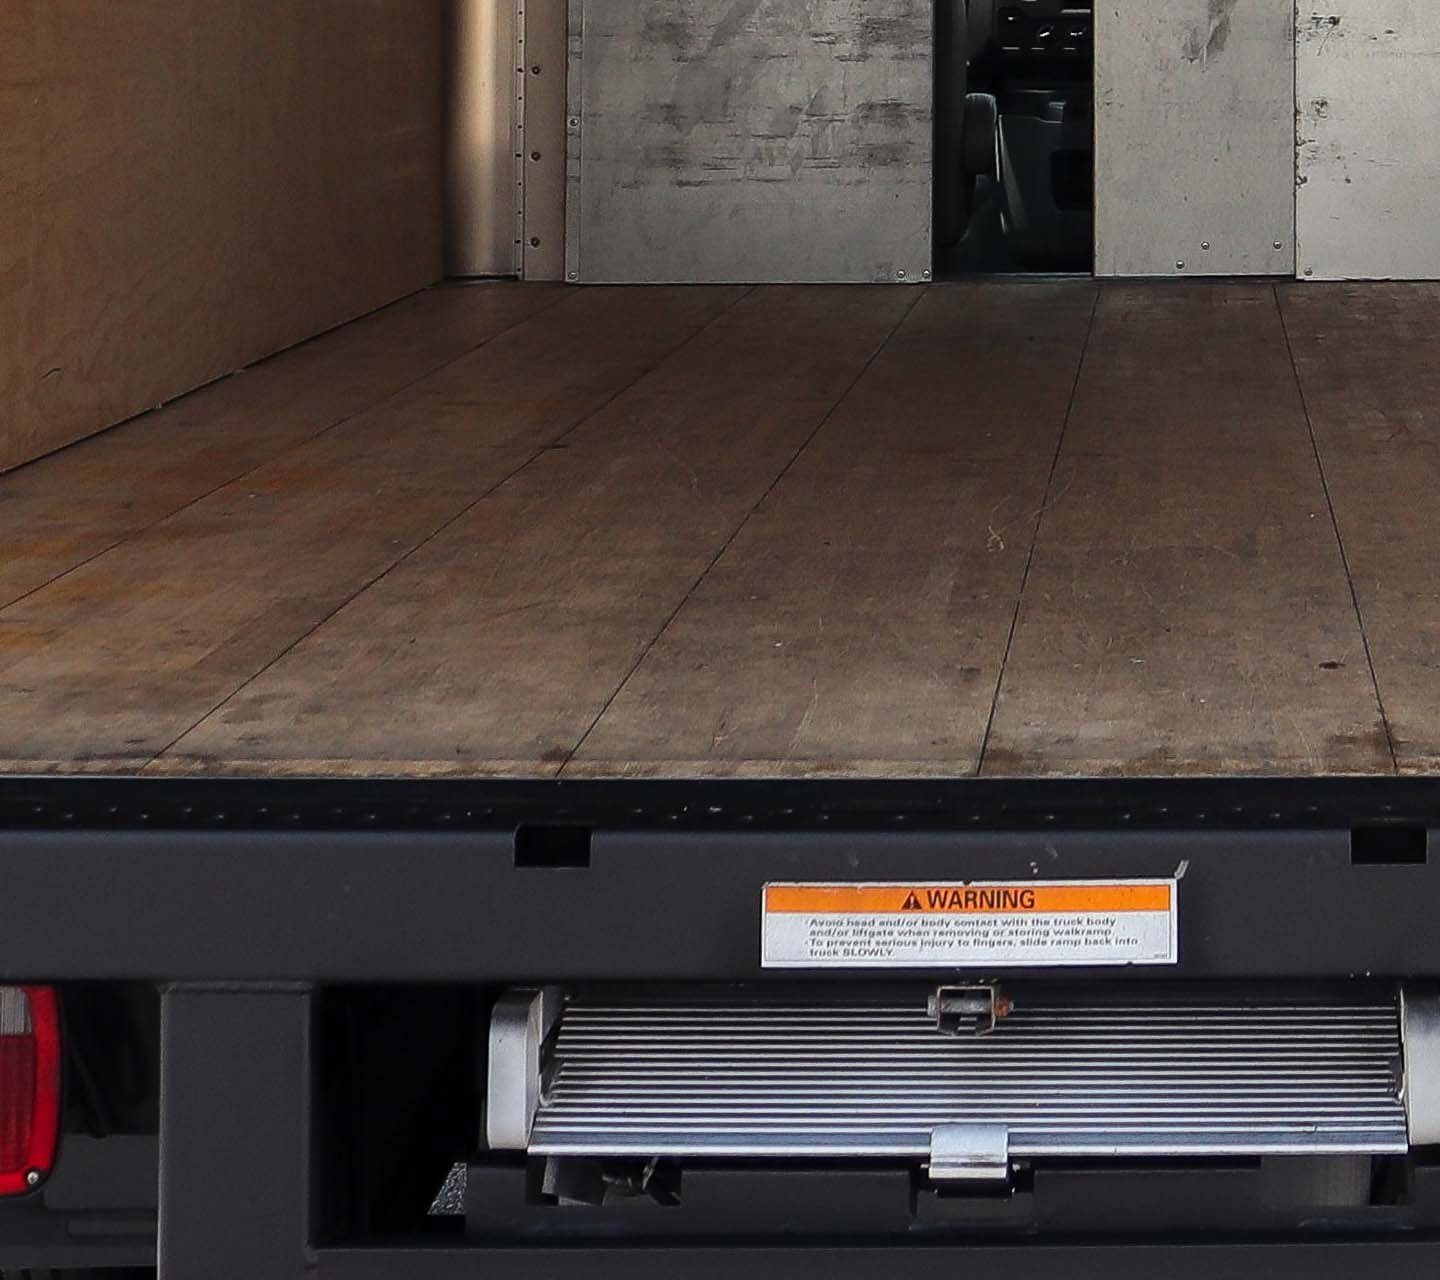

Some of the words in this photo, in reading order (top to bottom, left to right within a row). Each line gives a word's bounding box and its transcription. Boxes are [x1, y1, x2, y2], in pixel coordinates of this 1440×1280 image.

[926, 889, 1035, 909] WARNING
[809, 918, 844, 928] Avoid
[846, 918, 876, 928] head
[878, 918, 918, 928] and/or
[921, 918, 950, 930] body
[953, 919, 997, 928] contact
[1001, 918, 1027, 927] with
[1031, 918, 1050, 927] the
[1053, 917, 1083, 927] truck
[1086, 917, 1116, 929] body
[809, 928, 849, 938] and/or
[852, 928, 894, 939] liftgate
[897, 928, 930, 938] when
[933, 928, 989, 939] removing
[992, 929, 1005, 938] or
[1008, 927, 1050, 938] storing
[810, 939, 823, 948] To
[826, 939, 872, 949] prevent
[875, 939, 918, 948] serious
[920, 938, 954, 950] injury
[957, 938, 969, 947] to
[1020, 937, 1047, 947] slide
[1050, 938, 1082, 948] ramp
[1084, 937, 1112, 947] back
[1115, 937, 1139, 946] into
[809, 949, 840, 957] truck
